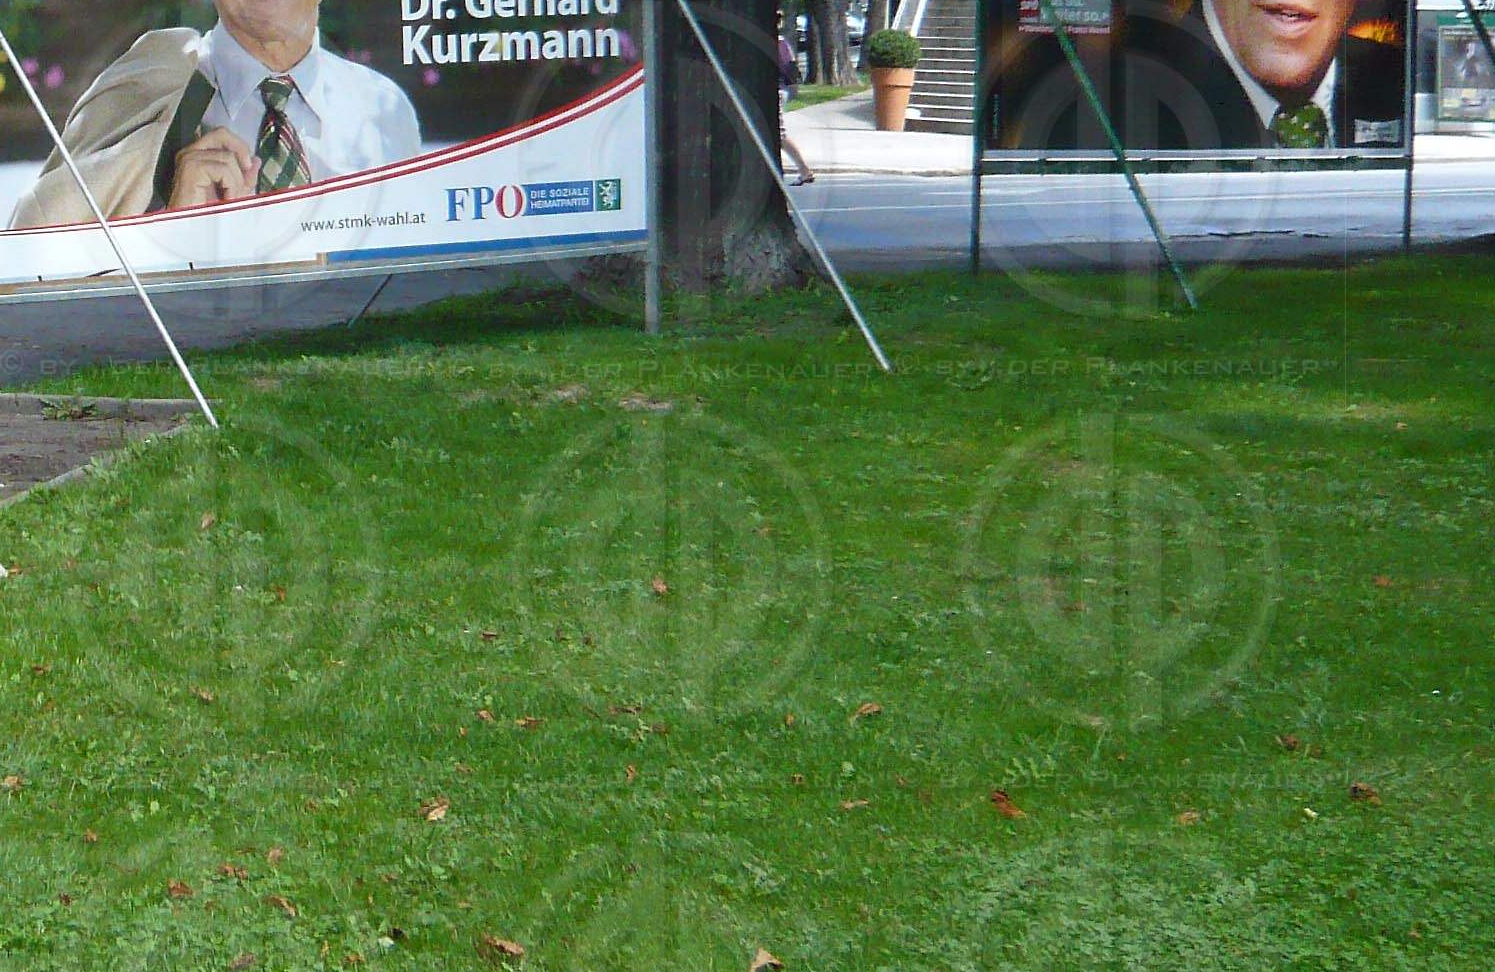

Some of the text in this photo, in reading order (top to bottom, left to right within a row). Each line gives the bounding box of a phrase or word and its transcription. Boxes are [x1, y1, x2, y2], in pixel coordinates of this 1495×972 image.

[402, 23, 620, 66] Kurzmann
[530, 187, 590, 199] DIE SOZIALE
[300, 211, 426, 233] www.stmk-wahl.at
